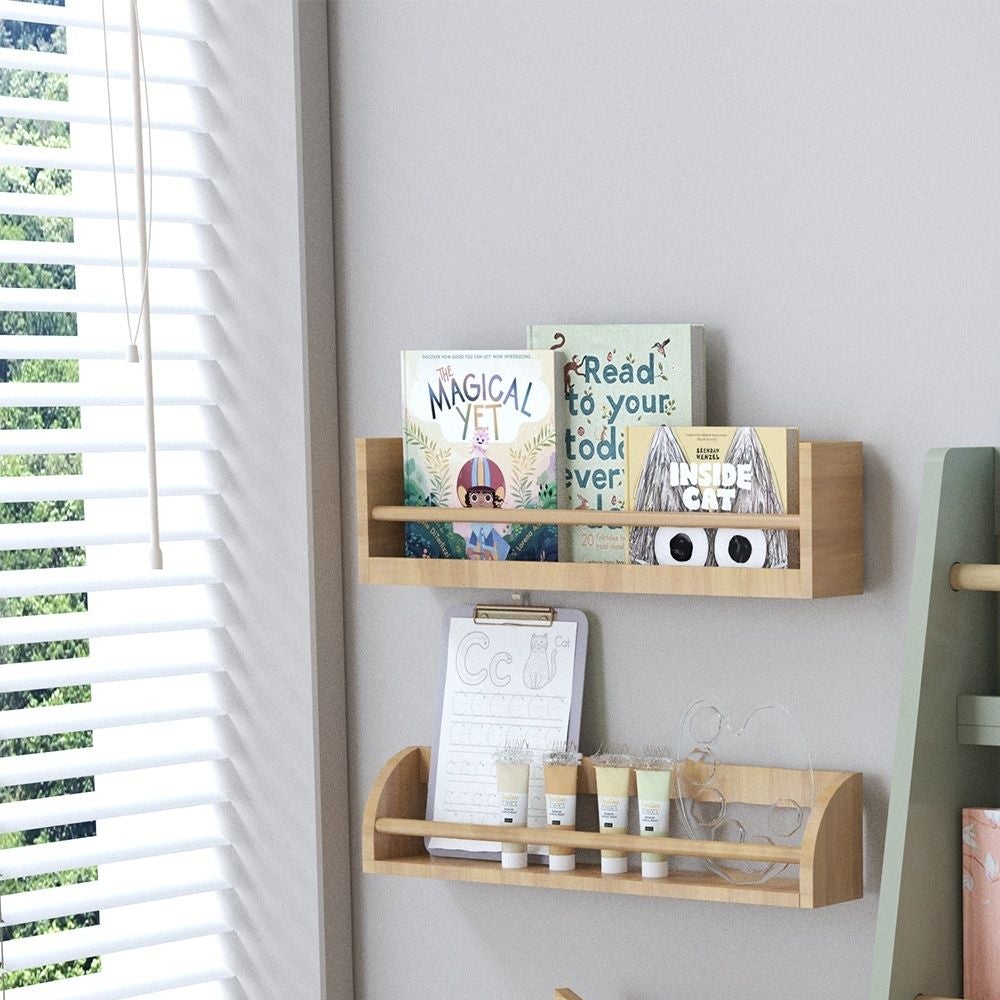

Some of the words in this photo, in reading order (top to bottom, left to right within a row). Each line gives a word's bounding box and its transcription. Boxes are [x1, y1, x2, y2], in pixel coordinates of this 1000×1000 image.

[436, 365, 454, 383] THE
[585, 352, 654, 385] Read
[428, 373, 533, 419] MAGICAL
[565, 388, 595, 416] to
[606, 394, 670, 424] your
[456, 403, 502, 440] YET
[565, 426, 624, 460] tod
[670, 460, 753, 490] INSIDE
[682, 486, 736, 512] CAT
